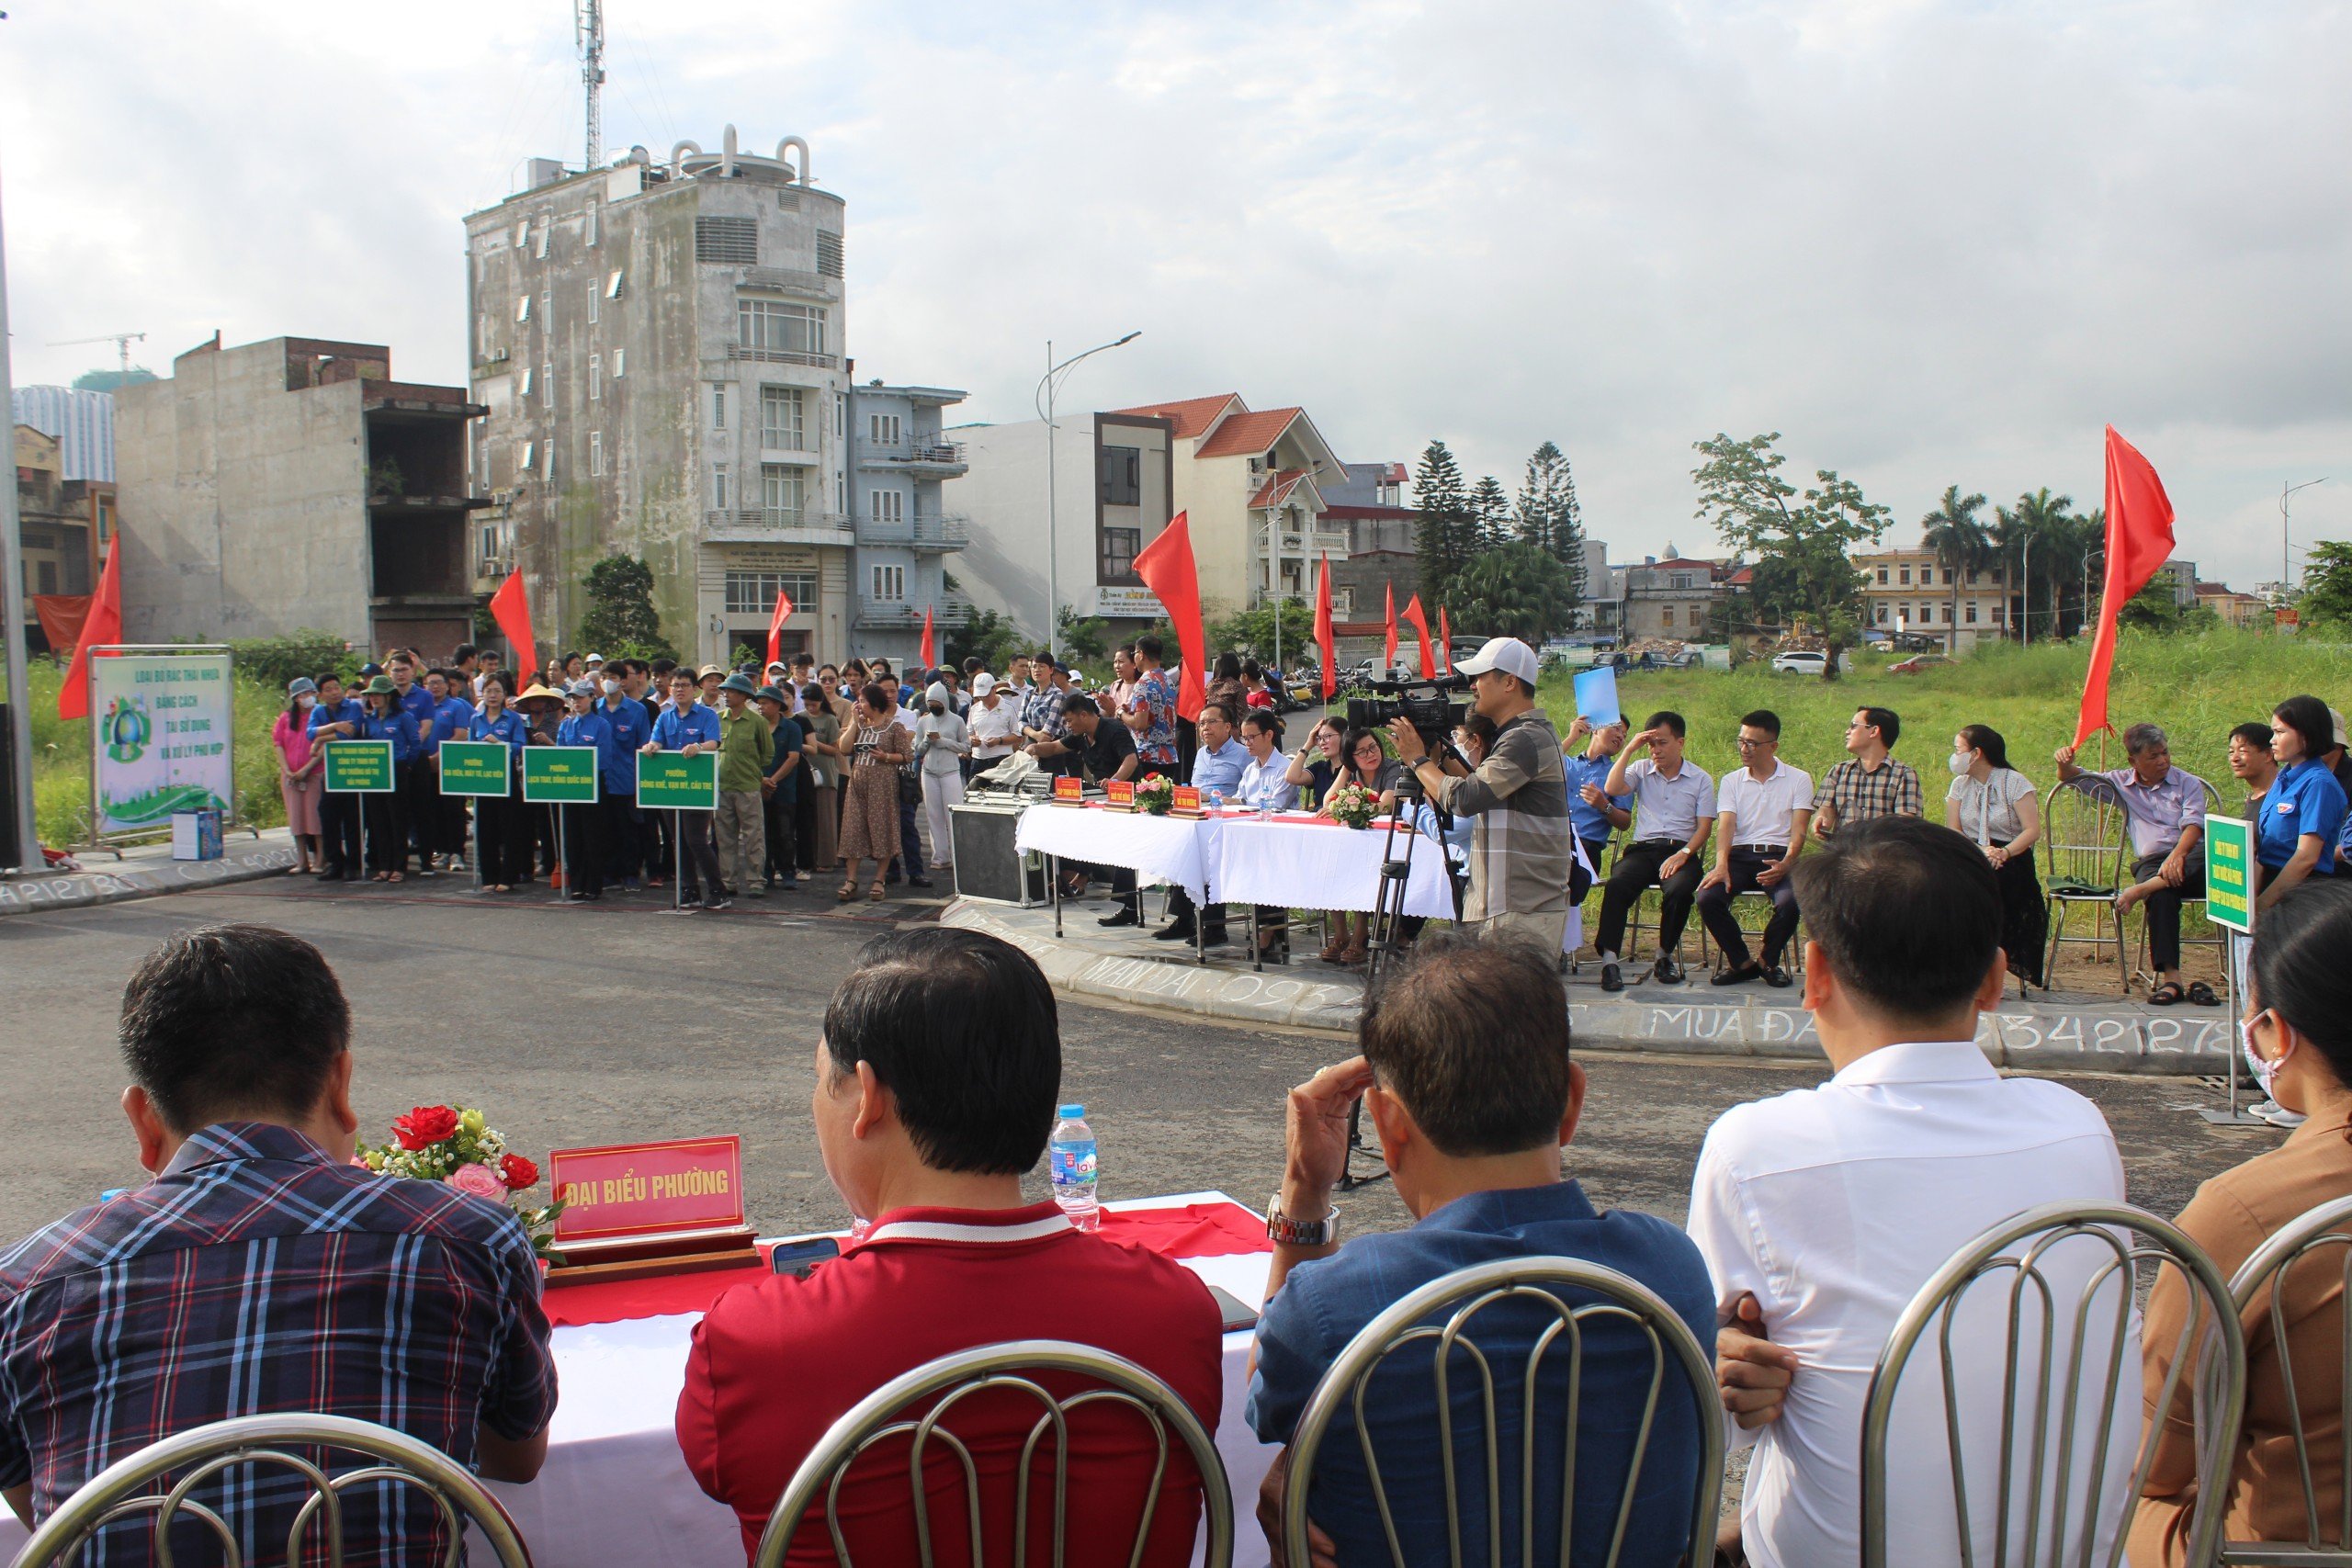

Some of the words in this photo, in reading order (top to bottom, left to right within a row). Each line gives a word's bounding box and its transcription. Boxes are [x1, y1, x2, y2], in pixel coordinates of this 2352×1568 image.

[165, 668, 182, 682] RÁC
[178, 694, 198, 708] CÁCH
[1650, 1008, 1744, 1042] MUA
[566, 1181, 597, 1212] ĐẠI
[603, 1168, 647, 1204] BIỂU
[651, 1166, 729, 1200] PHƯỜNG
